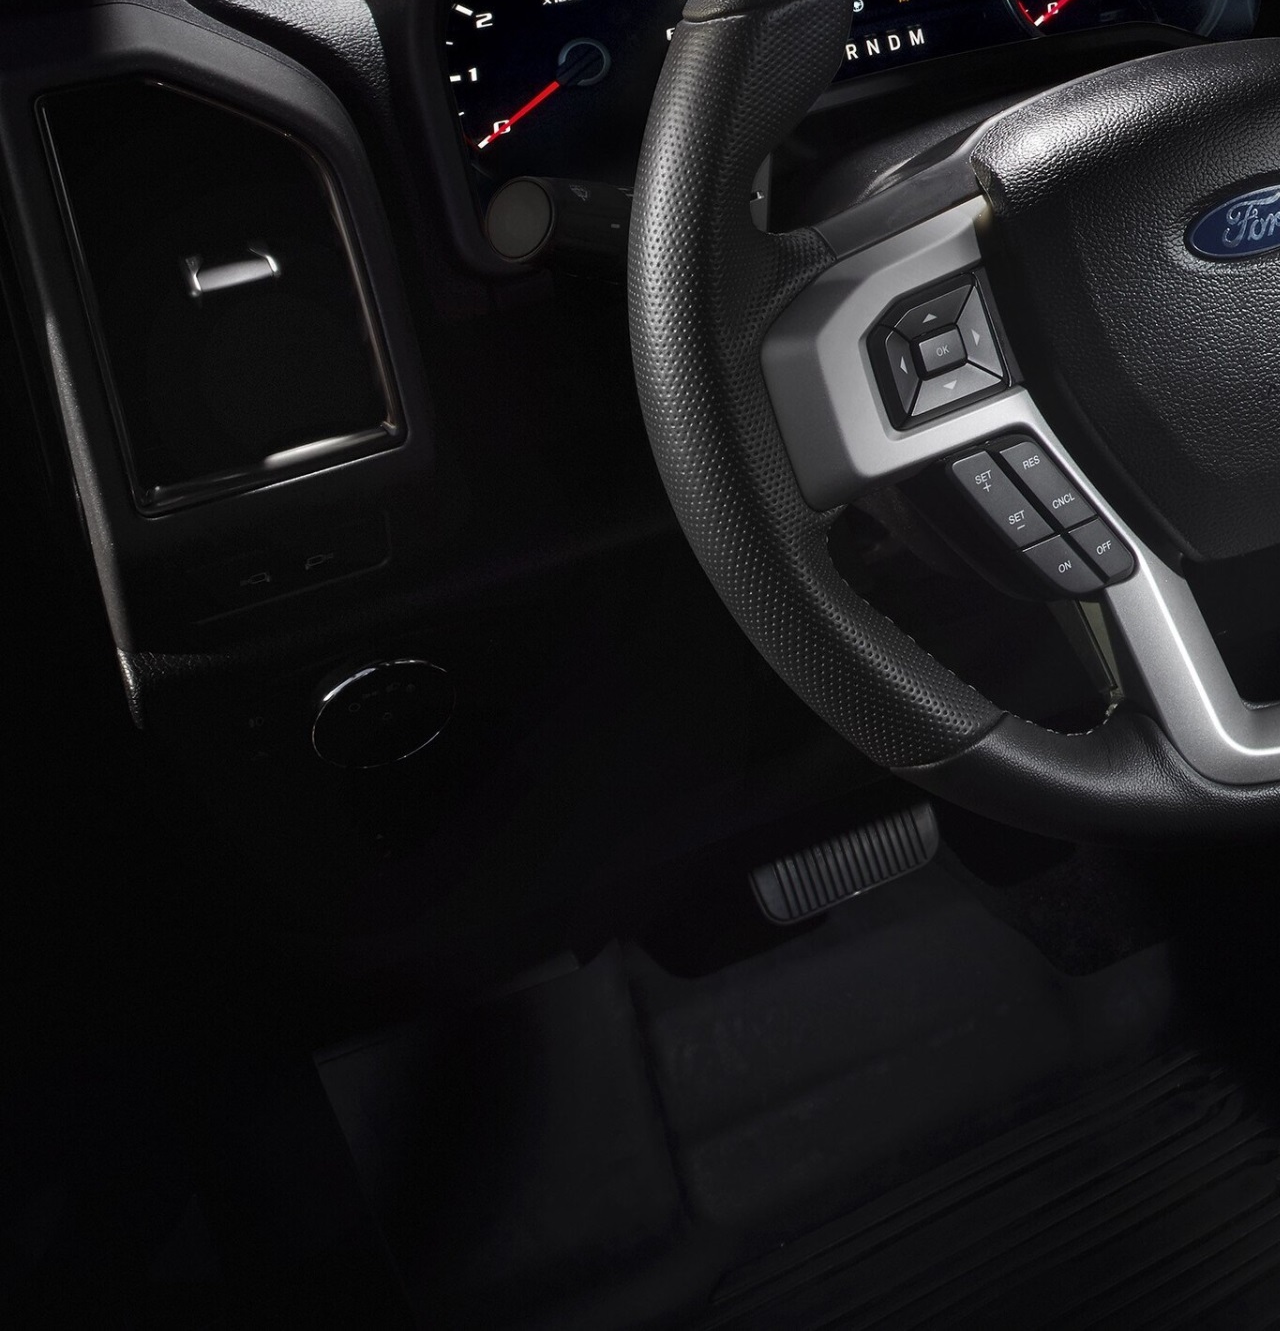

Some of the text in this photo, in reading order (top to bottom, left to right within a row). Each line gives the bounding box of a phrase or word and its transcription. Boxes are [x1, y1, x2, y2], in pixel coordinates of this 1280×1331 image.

[475, 12, 493, 29] 2
[845, 29, 925, 60] R N D M
[468, 66, 478, 82] 1
[936, 345, 950, 357] OK
[1022, 455, 1041, 470] RES
[974, 470, 992, 485] SET
[1052, 493, 1075, 510] CNCL
[1008, 510, 1026, 525] SET
[1096, 540, 1112, 555] OFF
[1057, 560, 1072, 573] ON
